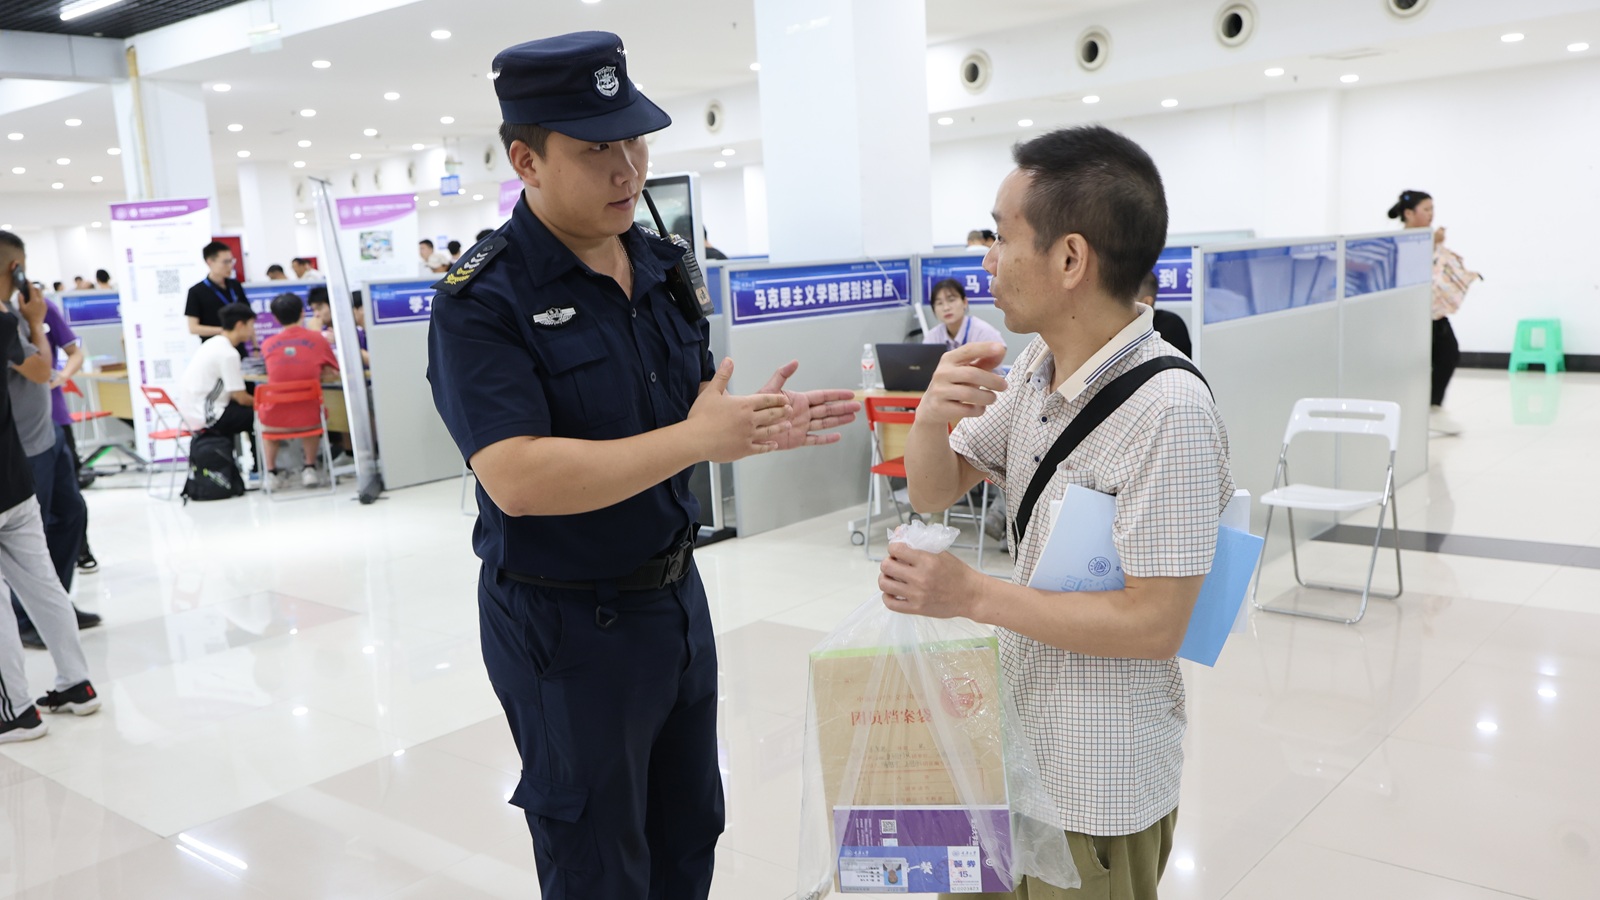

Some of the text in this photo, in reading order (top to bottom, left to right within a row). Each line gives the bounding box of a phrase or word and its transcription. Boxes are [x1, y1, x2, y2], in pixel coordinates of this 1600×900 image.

[754, 278, 895, 311] 马克思主义学院报到注册点
